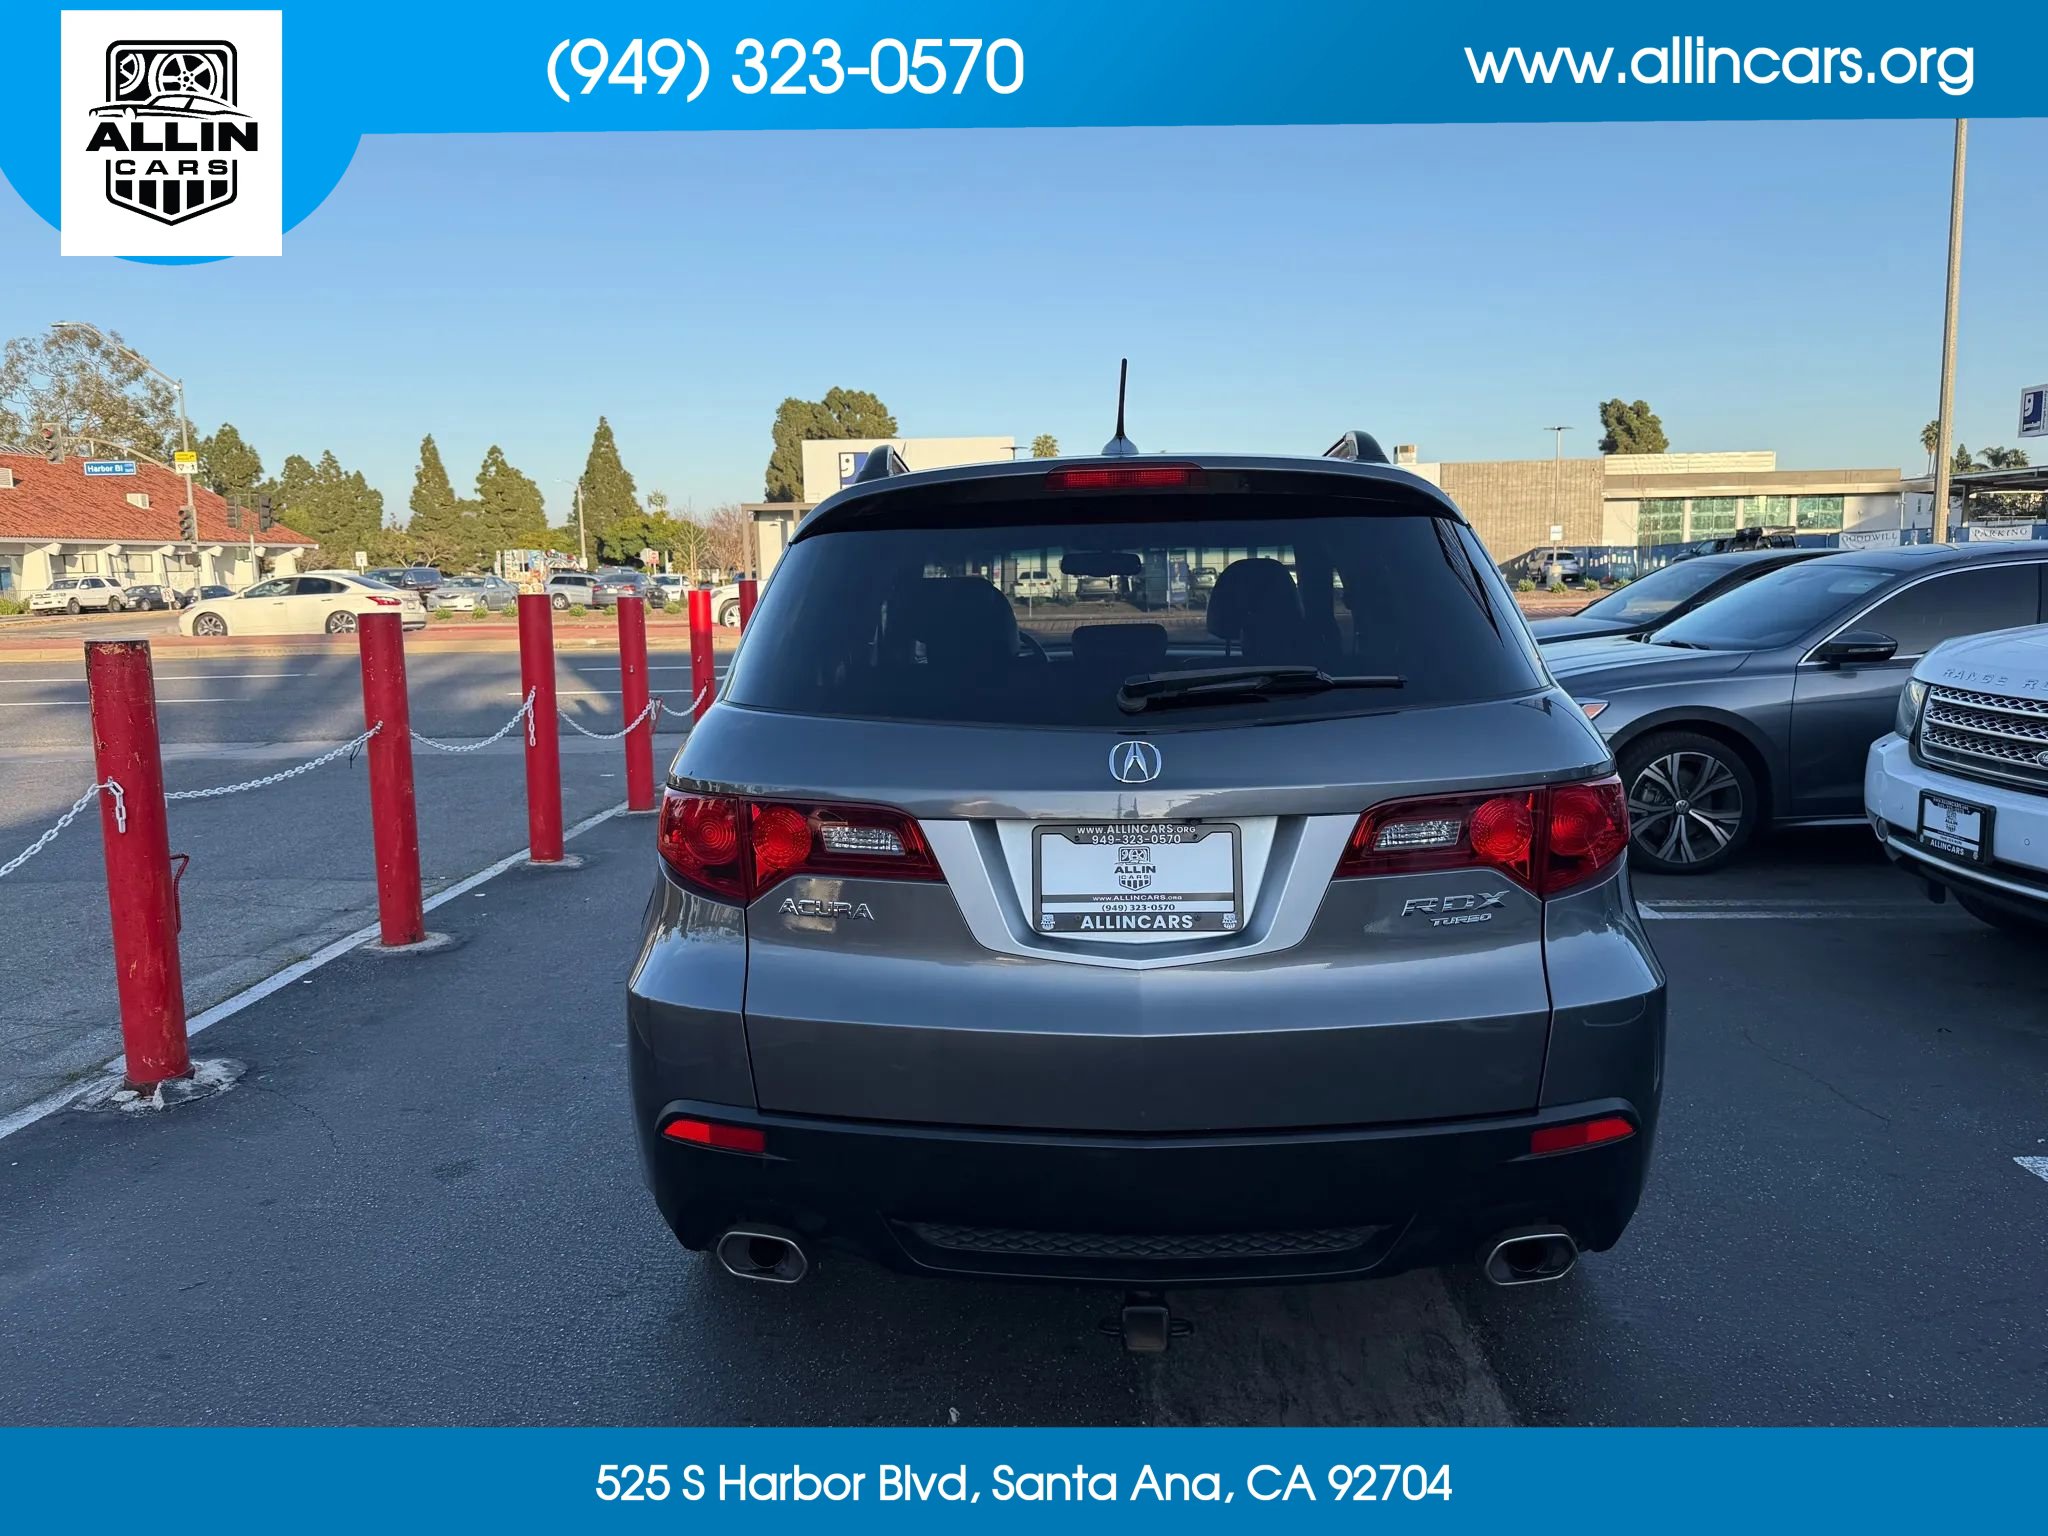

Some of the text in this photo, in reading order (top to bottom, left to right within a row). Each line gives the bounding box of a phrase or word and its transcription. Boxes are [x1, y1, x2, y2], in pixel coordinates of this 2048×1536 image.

[87, 464, 114, 473] Harbor
[1974, 527, 2028, 537] PARKING
[1942, 668, 2009, 686] RANGE
[1092, 834, 1181, 845] 949-323-0570
[1930, 839, 1965, 855] ALLINCARS
[1114, 865, 1156, 874] ALLIN
[779, 897, 875, 921] ACURA
[1102, 904, 1128, 912] (949)
[1401, 890, 1510, 917] RDX
[1080, 915, 1194, 929] ALLINCARS
[1428, 912, 1492, 928] TURBO
